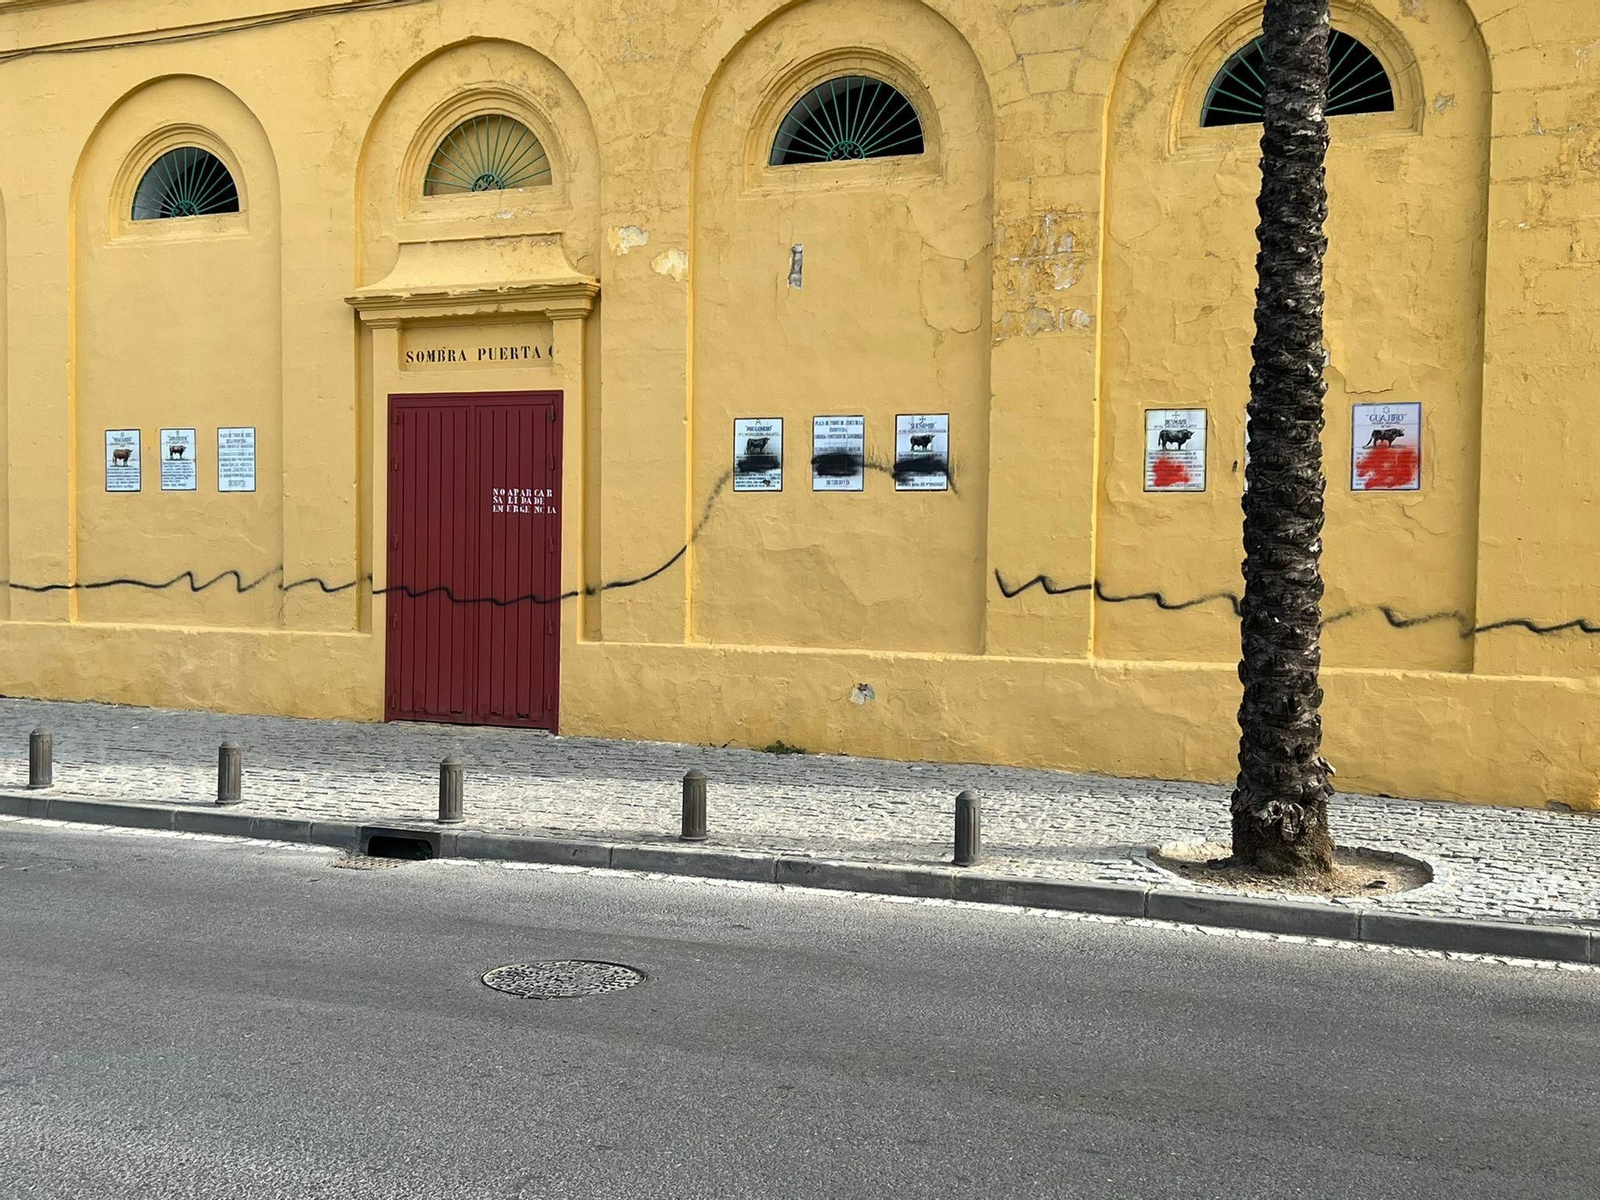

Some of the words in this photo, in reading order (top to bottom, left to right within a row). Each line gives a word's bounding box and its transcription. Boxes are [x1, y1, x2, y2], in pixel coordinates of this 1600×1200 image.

[405, 348, 467, 363] SOMBRA
[477, 346, 542, 361] PUERTA
[492, 496, 532, 504] SALIDA
[492, 505, 556, 514] EMERGENCIA
